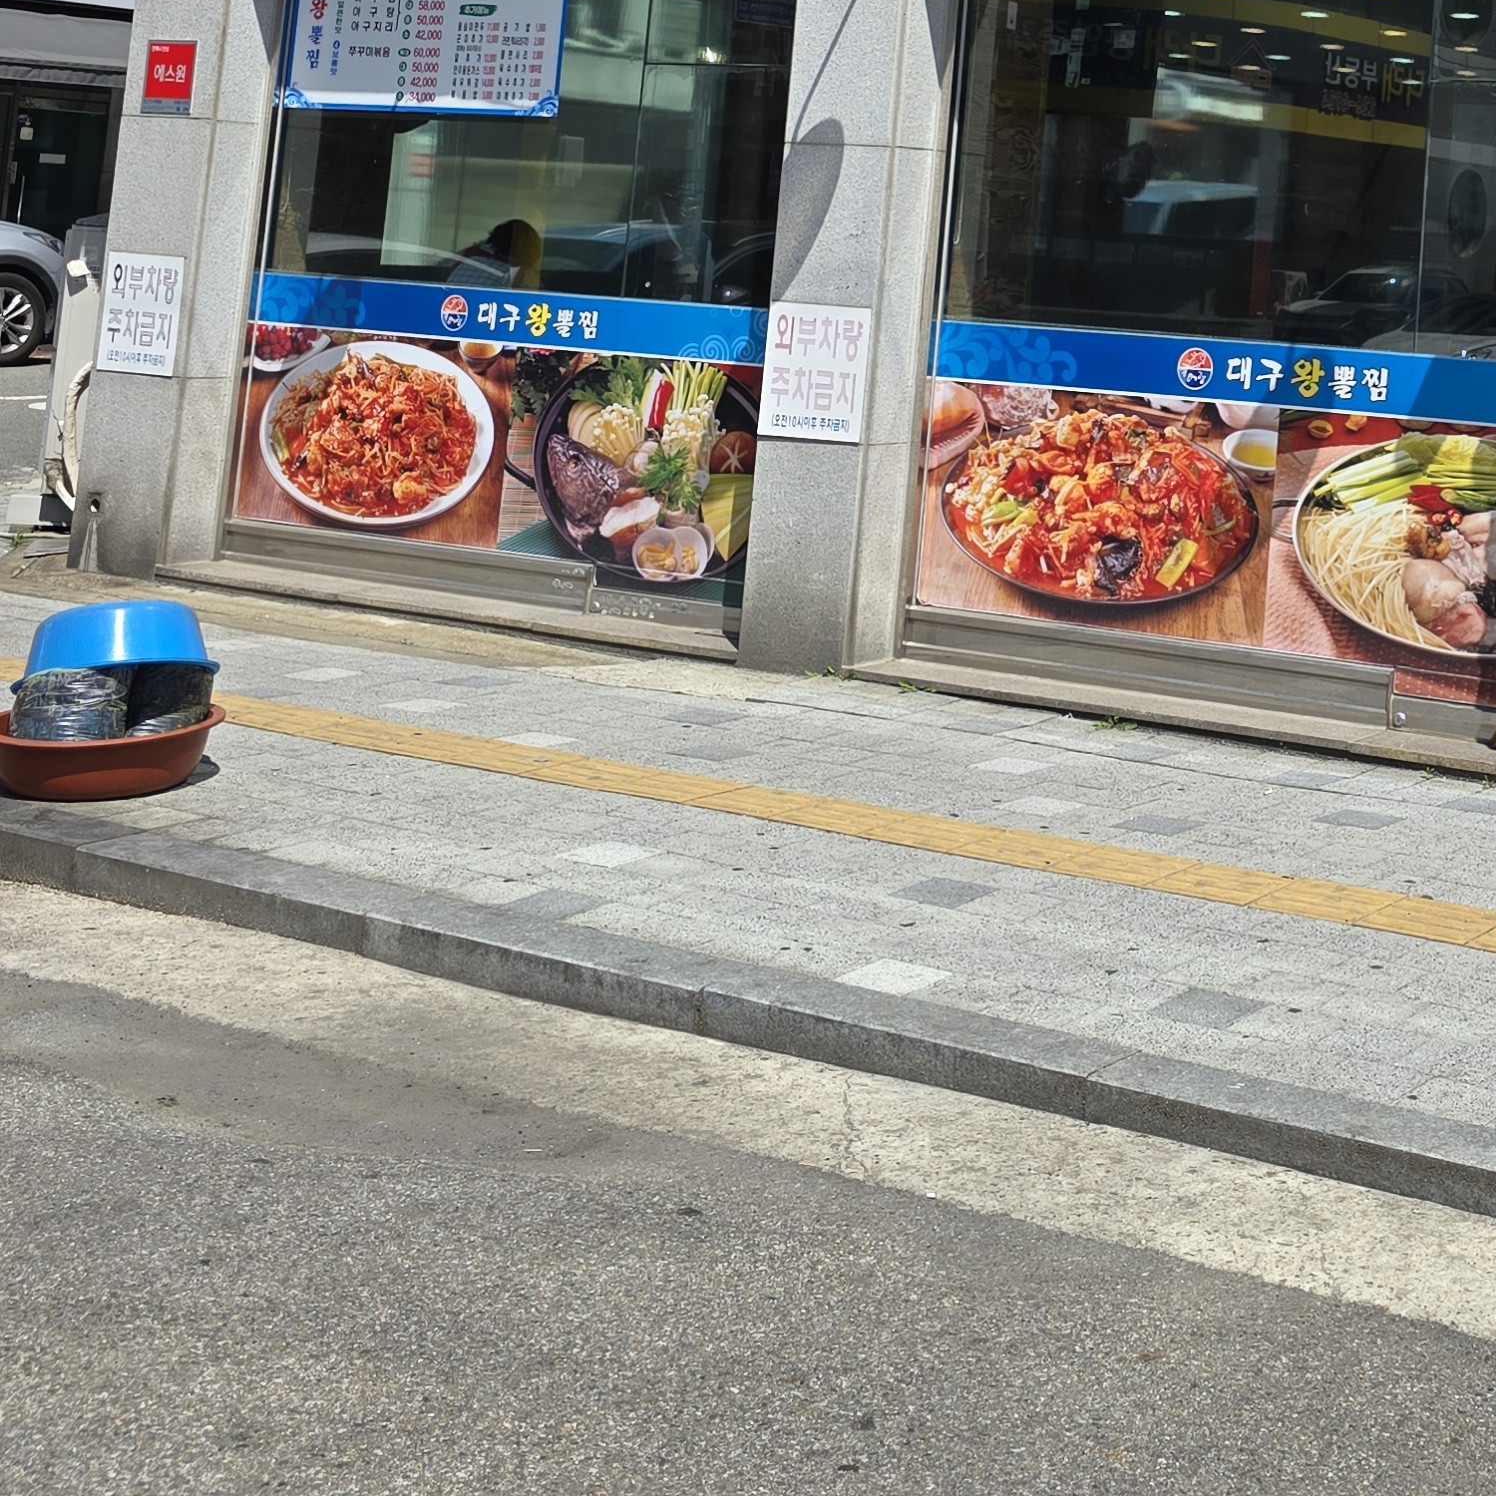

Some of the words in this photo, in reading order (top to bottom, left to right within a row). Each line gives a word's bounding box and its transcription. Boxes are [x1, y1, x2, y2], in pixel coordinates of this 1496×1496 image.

[418, 0, 445, 11] 58,000
[416, 15, 443, 26] 50,000
[415, 30, 442, 40] 42,000
[413, 47, 440, 58] 60,000
[411, 62, 439, 72] 50,000
[153, 63, 187, 83] 에스원
[410, 76, 437, 87] 42,000
[111, 263, 178, 305] 외부차량
[107, 308, 172, 350] 주차금지
[774, 314, 864, 362] 외부차량
[771, 366, 857, 414] 주차금지
